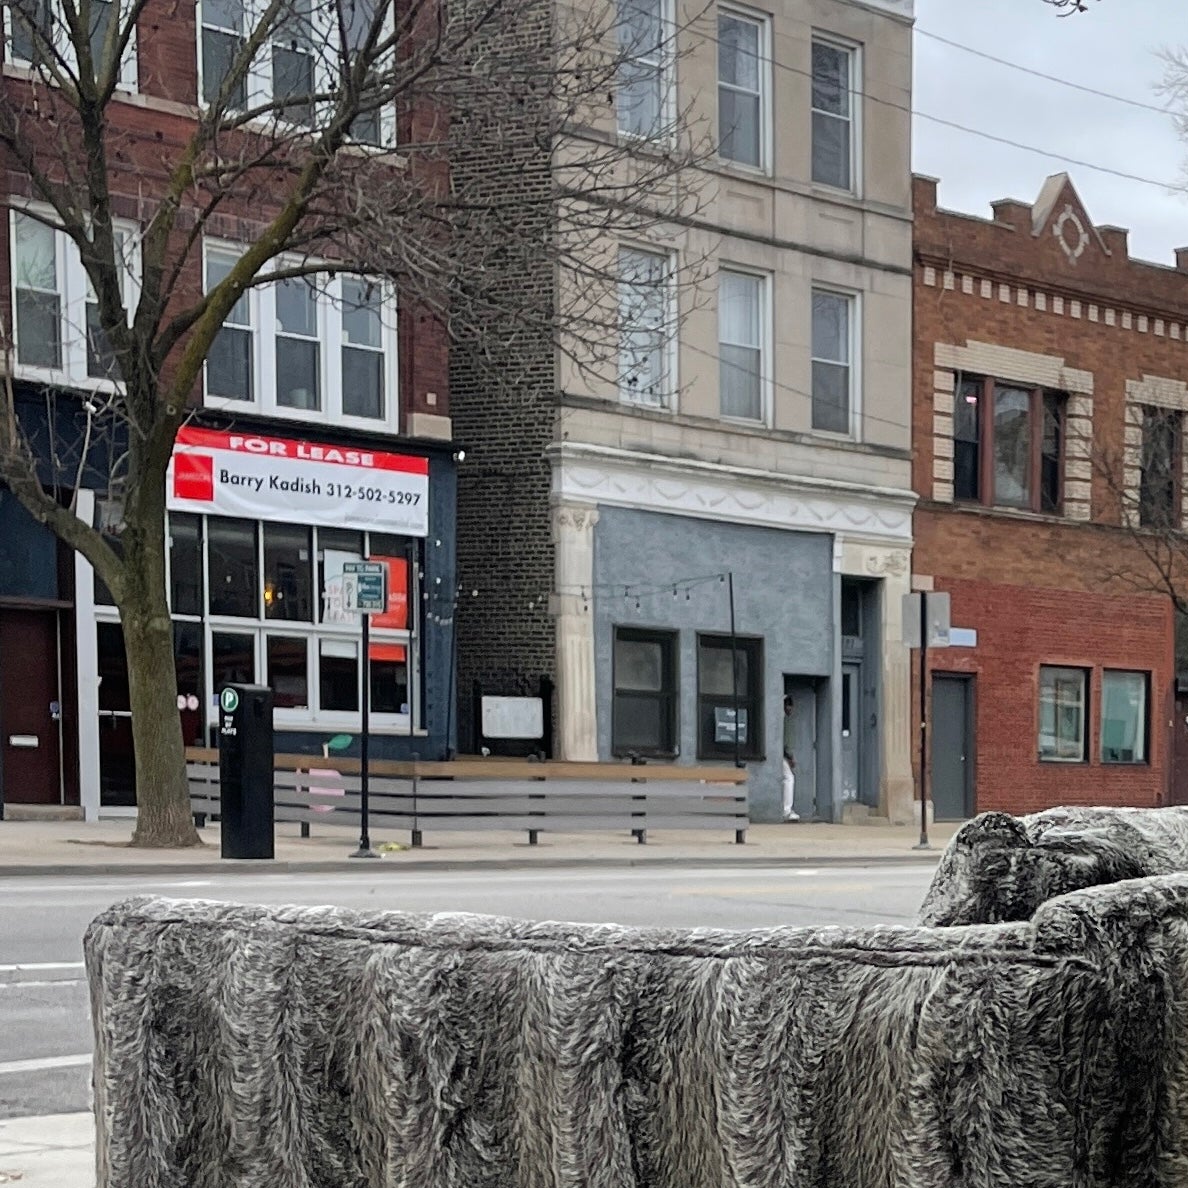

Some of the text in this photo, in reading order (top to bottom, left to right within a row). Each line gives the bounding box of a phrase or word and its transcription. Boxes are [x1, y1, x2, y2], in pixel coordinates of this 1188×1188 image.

[229, 436, 374, 467] FOR LEASE
[219, 469, 264, 492] Barry
[269, 475, 321, 496] Kadish
[326, 482, 421, 507] 312-502-5297
